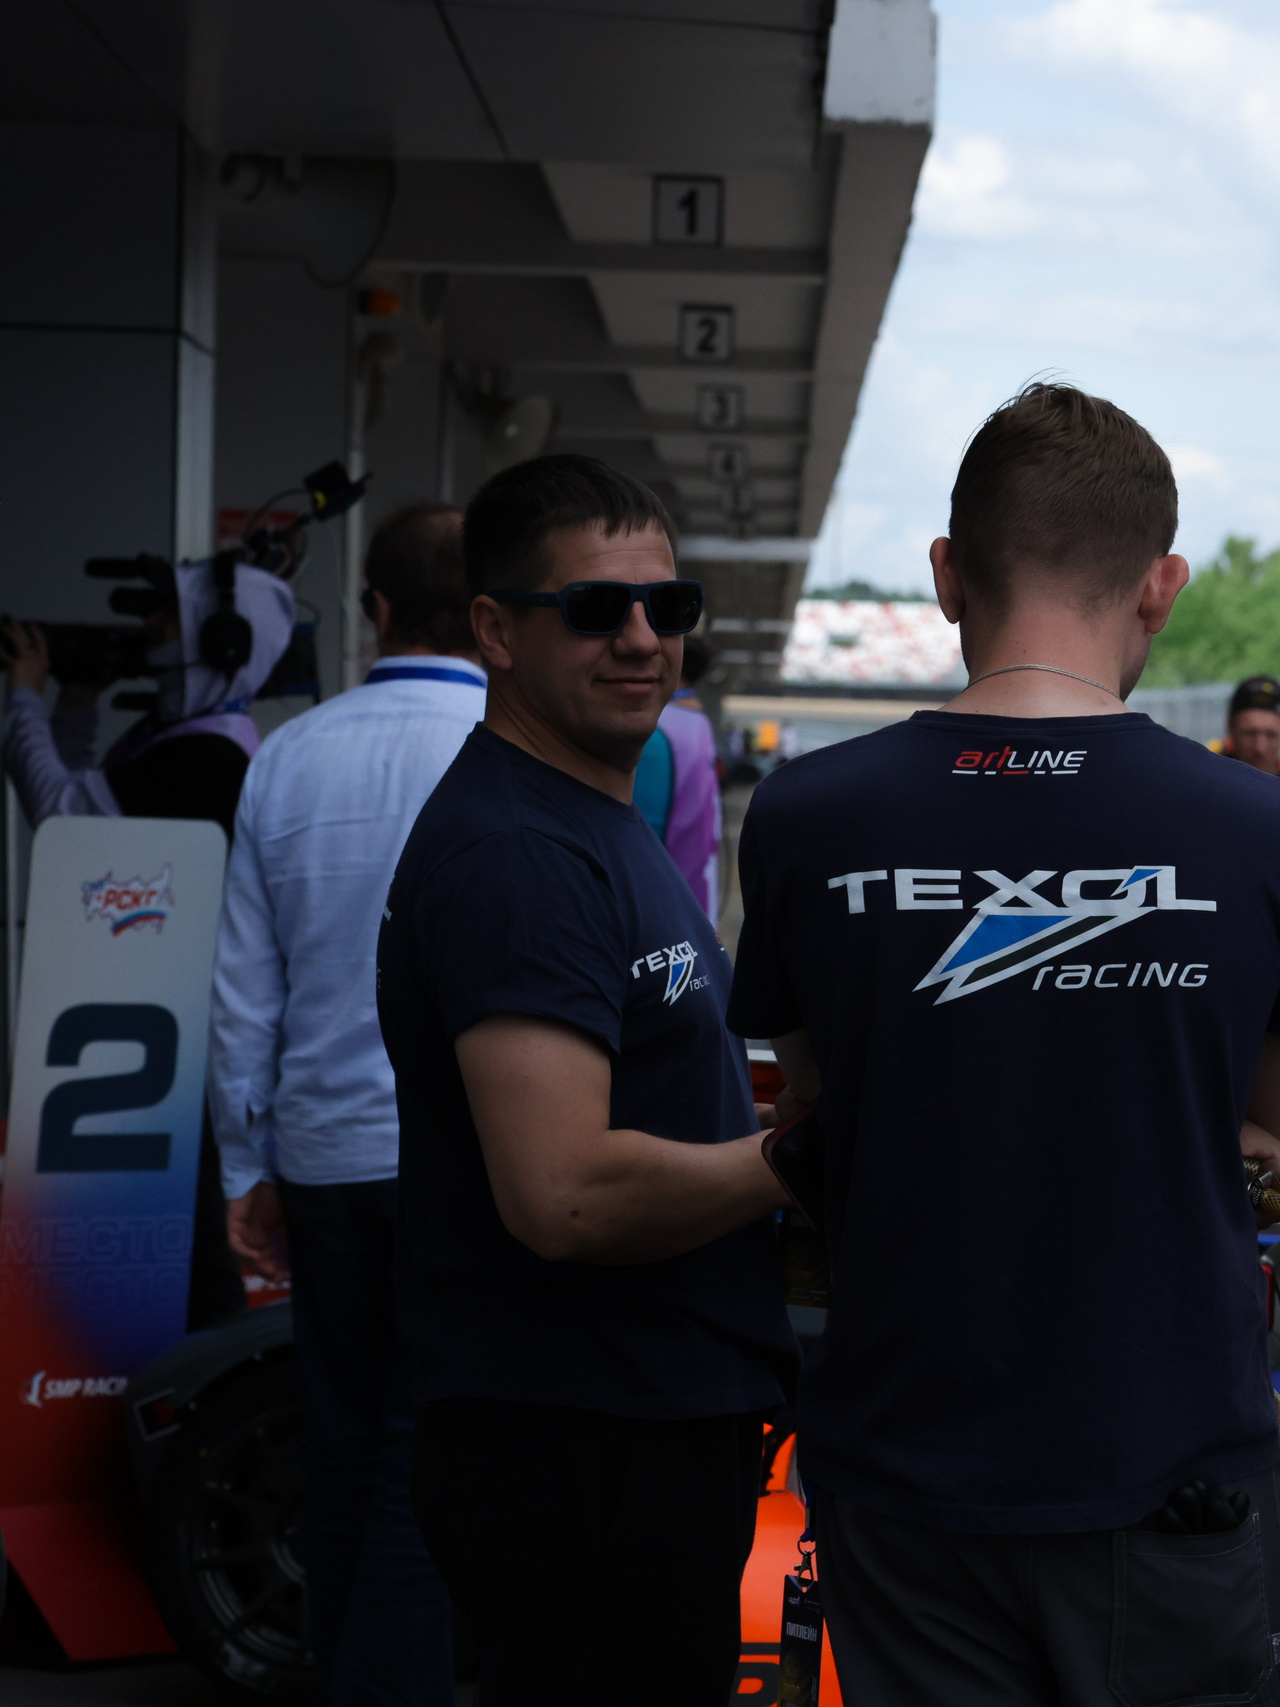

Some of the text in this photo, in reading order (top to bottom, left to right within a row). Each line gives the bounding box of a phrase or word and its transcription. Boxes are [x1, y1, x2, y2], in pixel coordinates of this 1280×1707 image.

[678, 188, 698, 235] 1
[698, 317, 717, 352] 2
[954, 745, 1088, 769] artLINE
[827, 865, 1218, 914] TEXOL
[630, 941, 698, 979] TEXOL
[36, 1003, 178, 1173] 2
[0, 1214, 192, 1264] МЕСТО
[785, 1621, 818, 1642] ПИТЛЕЙН
